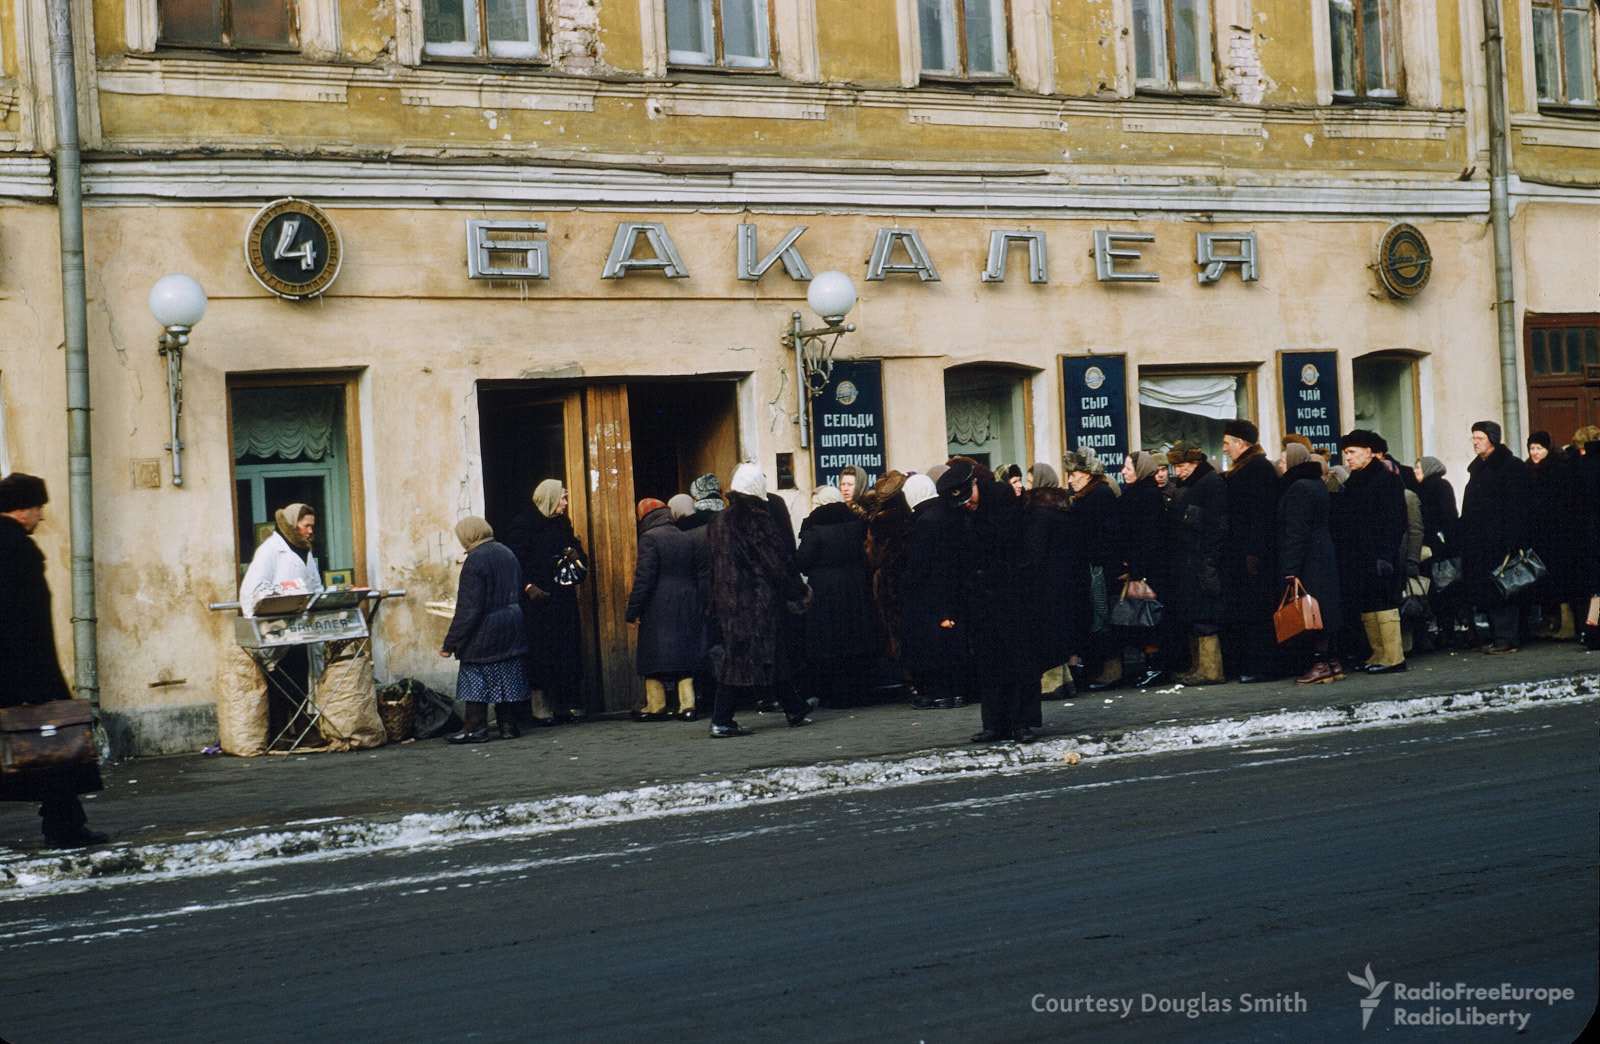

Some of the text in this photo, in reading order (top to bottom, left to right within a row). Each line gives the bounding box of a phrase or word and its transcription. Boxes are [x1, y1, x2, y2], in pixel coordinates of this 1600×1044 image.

[274, 221, 317, 270] 4
[465, 218, 1258, 284] БАКАЛЕЯ
[1299, 387, 1320, 401] ЧАЙ
[1081, 396, 1108, 410] СЫР
[1297, 407, 1327, 419] КОФЕ
[824, 414, 874, 428] СЕЛЬДИ
[1081, 414, 1112, 429] ЯЙЦА
[1295, 424, 1330, 436] КАКАО
[821, 433, 877, 447] ШПРОТЫ
[1077, 434, 1116, 448] МАСЛО
[821, 454, 881, 467] САРДИНЫ
[289, 618, 348, 633] БАКАЛЕЯ
